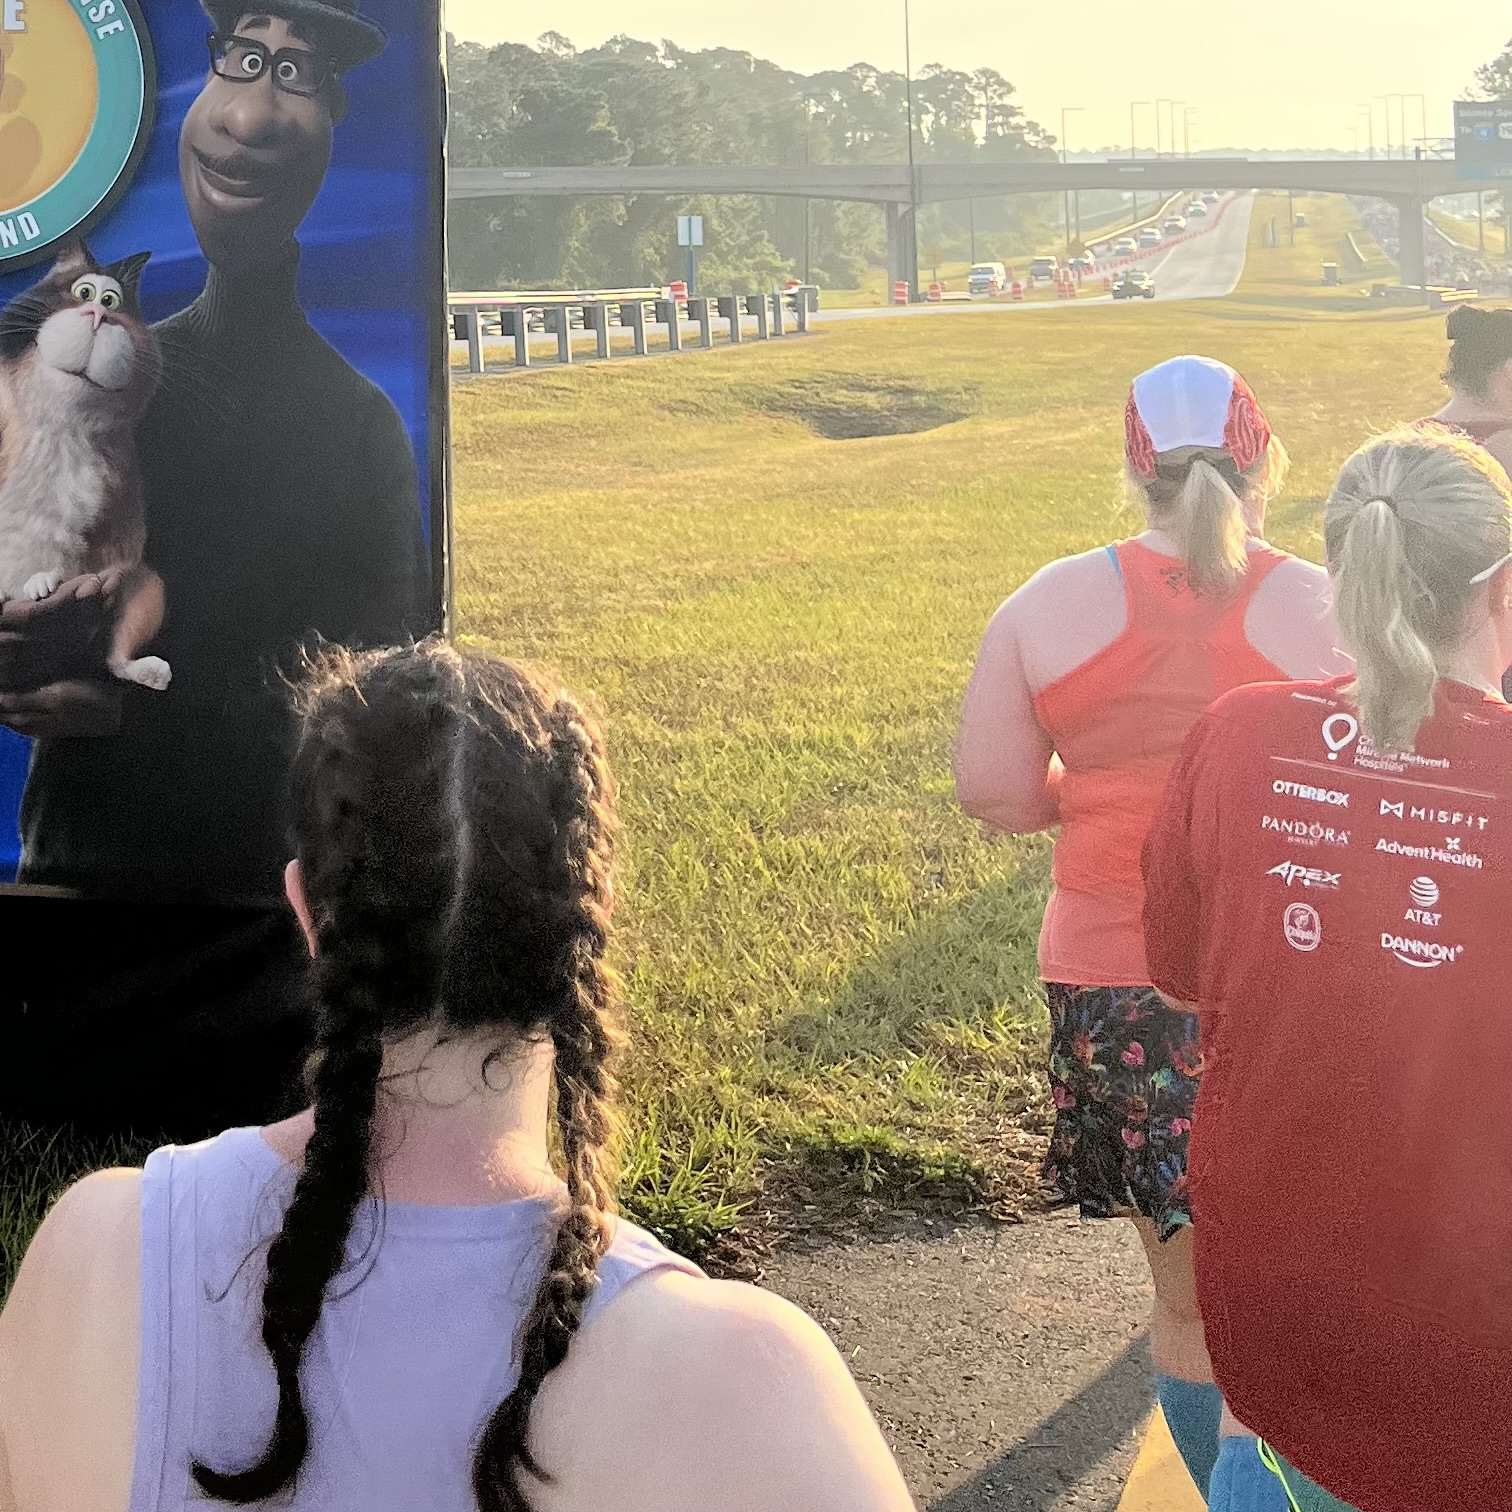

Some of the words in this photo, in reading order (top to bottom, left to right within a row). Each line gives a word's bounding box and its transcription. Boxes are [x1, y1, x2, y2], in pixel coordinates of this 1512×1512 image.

[1272, 779, 1349, 808] OTTERBOX
[1261, 815, 1349, 845] PANDORA
[1410, 806, 1488, 830] MISFIT
[1375, 838, 1484, 869] AdventHealth
[1404, 908, 1442, 926] AT&T
[1380, 933, 1455, 962] DANNON
